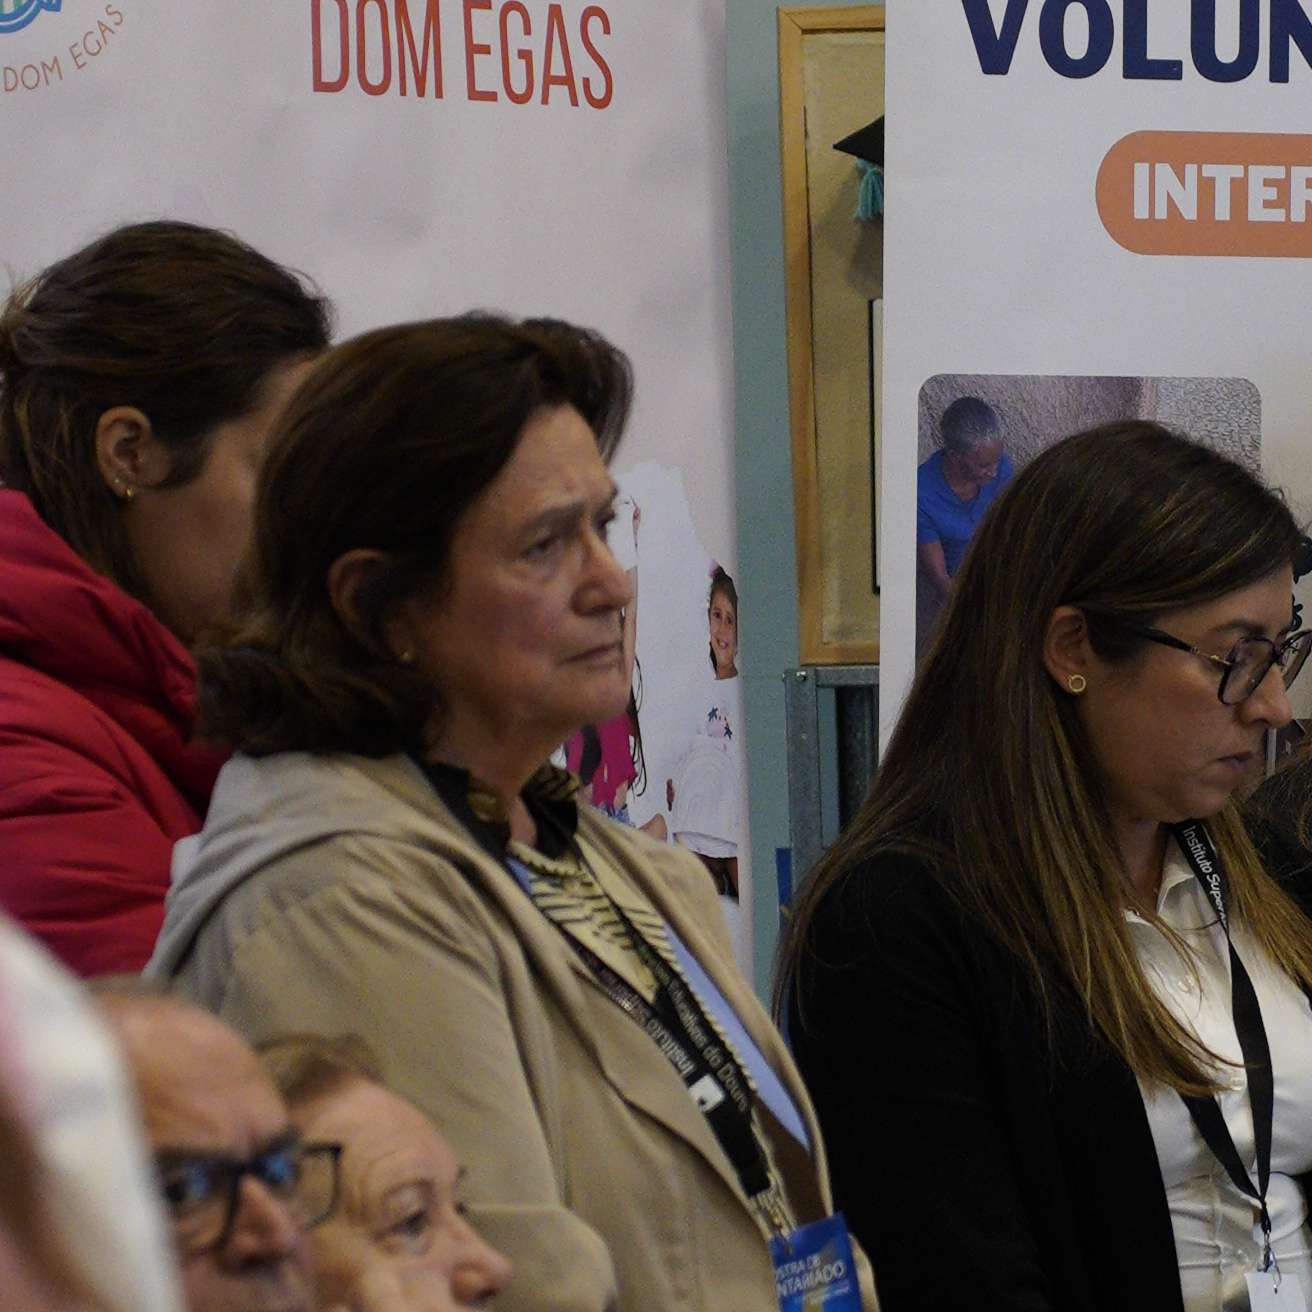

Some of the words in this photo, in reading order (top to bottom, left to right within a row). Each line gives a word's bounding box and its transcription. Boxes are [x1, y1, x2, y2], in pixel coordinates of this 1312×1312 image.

[3, 56, 63, 92] DOM
[68, 4, 123, 69] EGAS
[1183, 825, 1213, 874] Instituto
